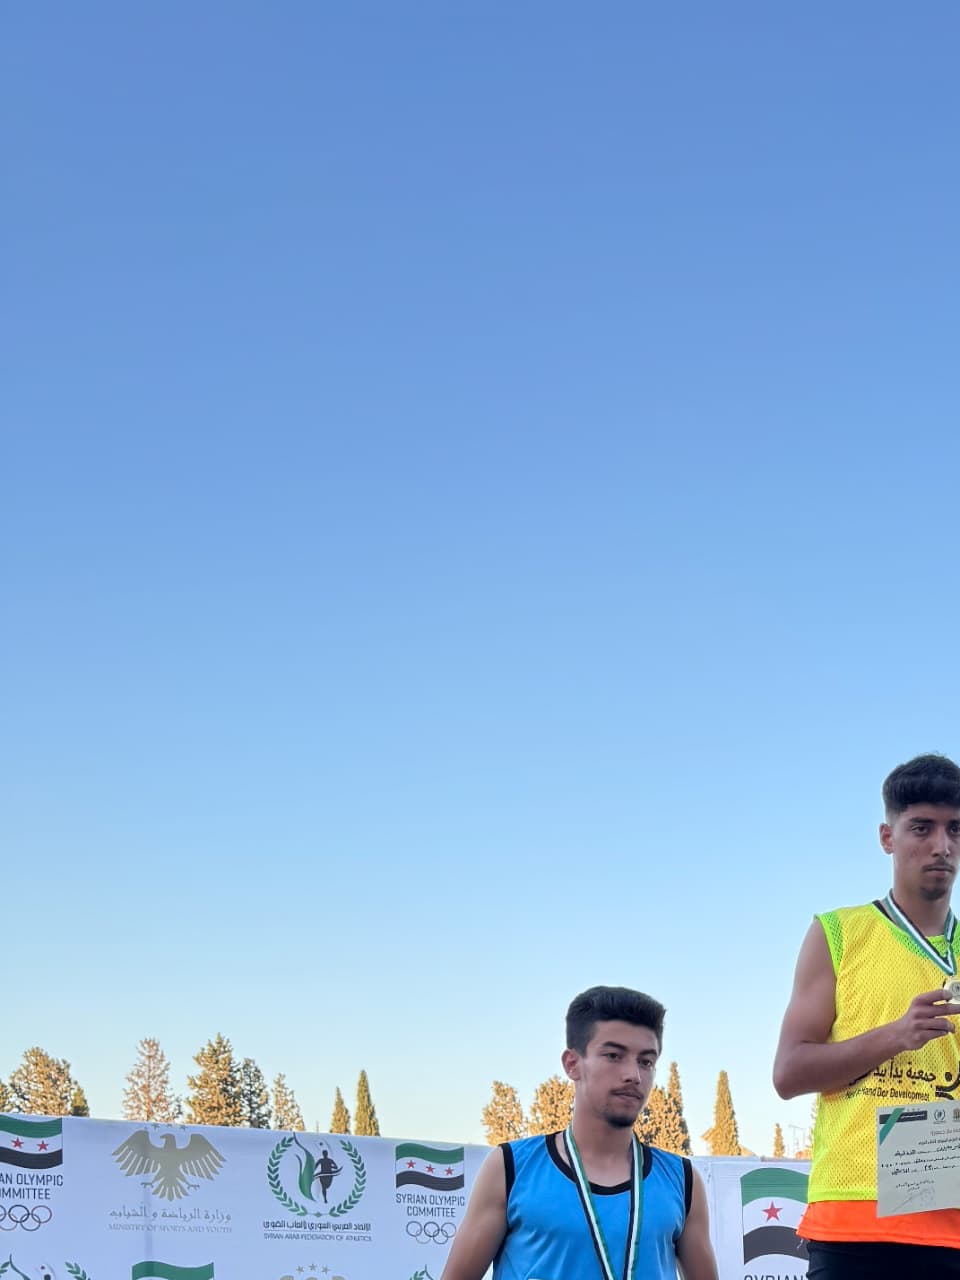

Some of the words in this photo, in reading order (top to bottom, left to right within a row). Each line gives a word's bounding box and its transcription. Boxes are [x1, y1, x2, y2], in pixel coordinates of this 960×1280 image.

[16, 1173, 64, 1187] OLYMPIC
[0, 1187, 51, 1200] MMITTEE
[396, 1193, 427, 1204] SYRIAN
[429, 1195, 465, 1206] OLYMPIC
[406, 1206, 456, 1218] COMMITTEE
